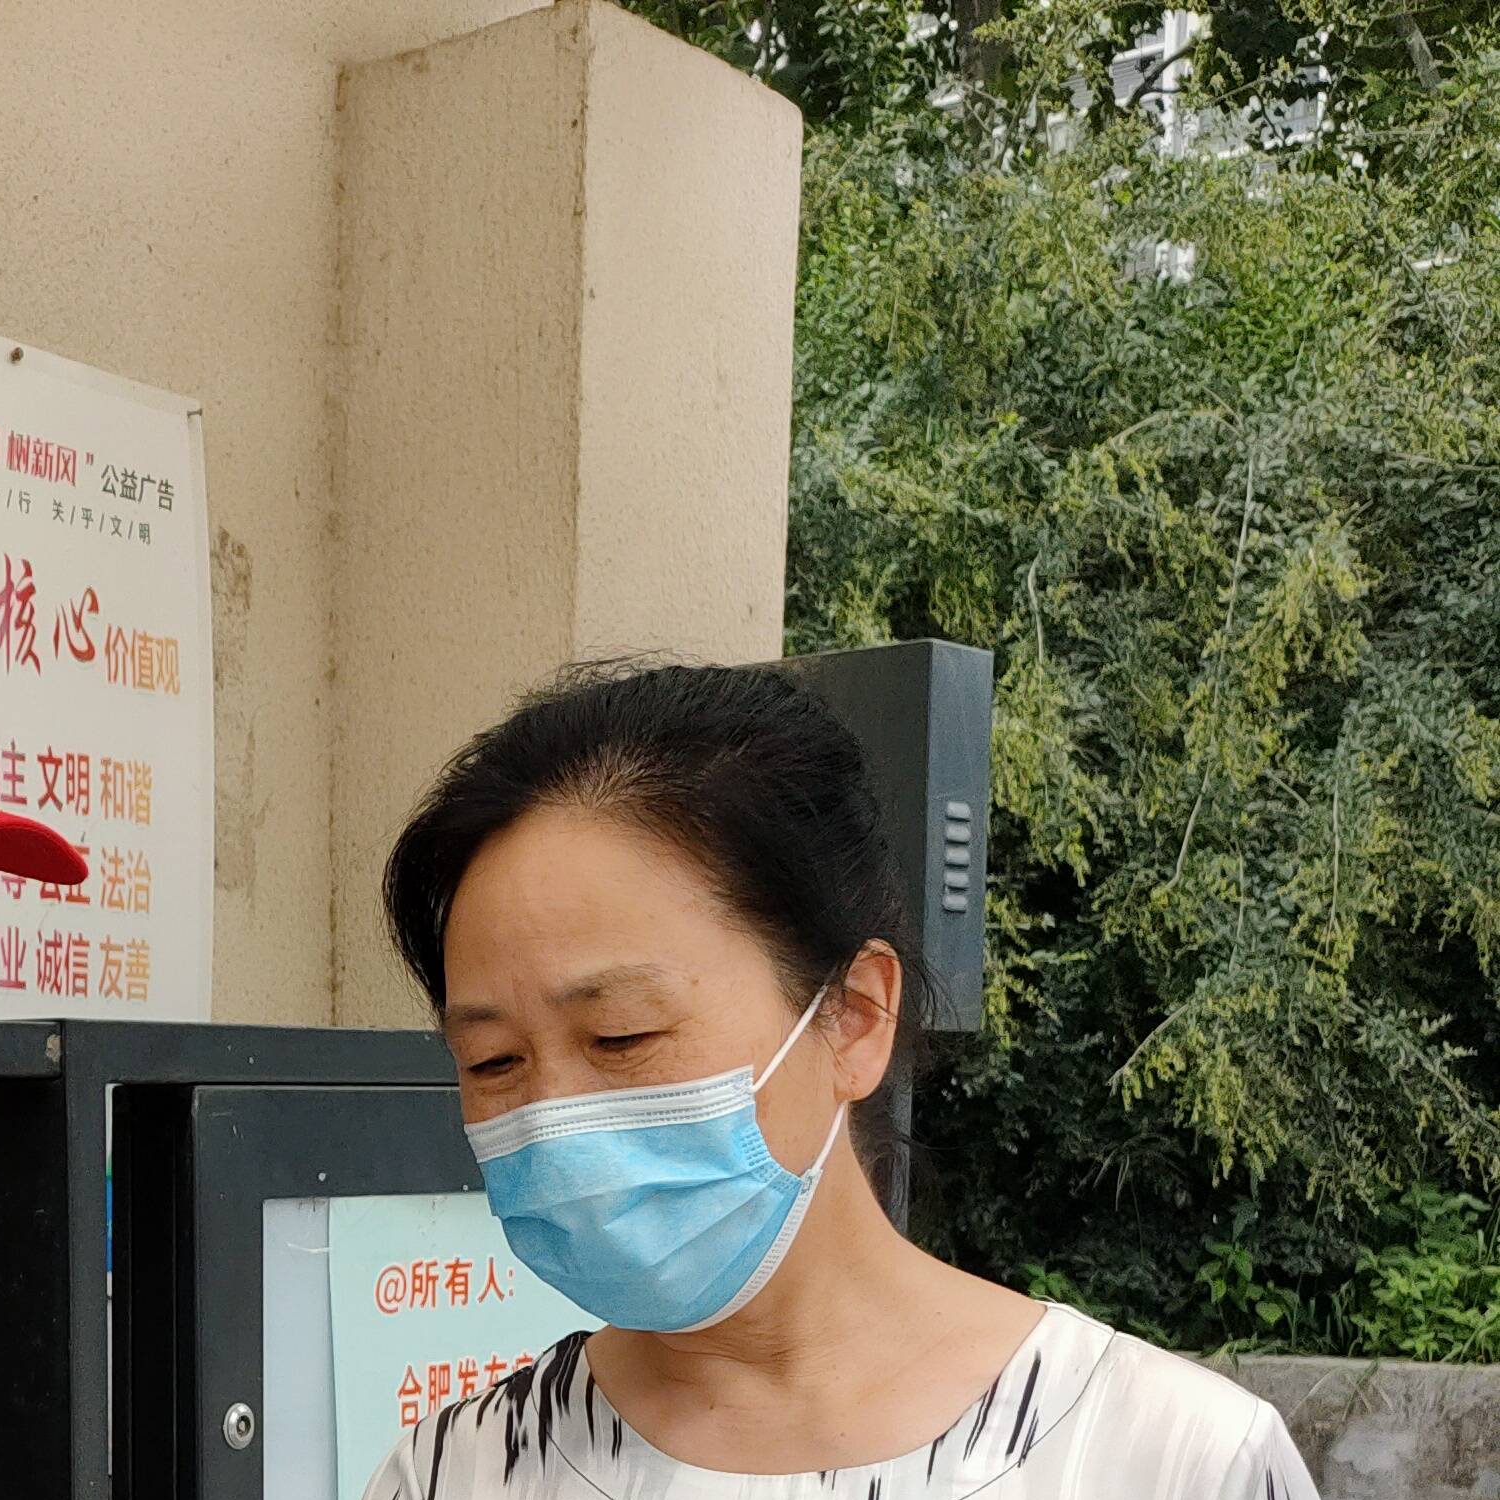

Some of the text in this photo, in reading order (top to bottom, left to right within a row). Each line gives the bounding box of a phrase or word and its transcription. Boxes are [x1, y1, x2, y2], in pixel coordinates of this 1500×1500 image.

[37, 745, 90, 816] 文明
[100, 757, 152, 825] 和谐
[101, 846, 151, 913] 法治
[36, 929, 90, 998] 诚信
[99, 935, 150, 1001] 友善
